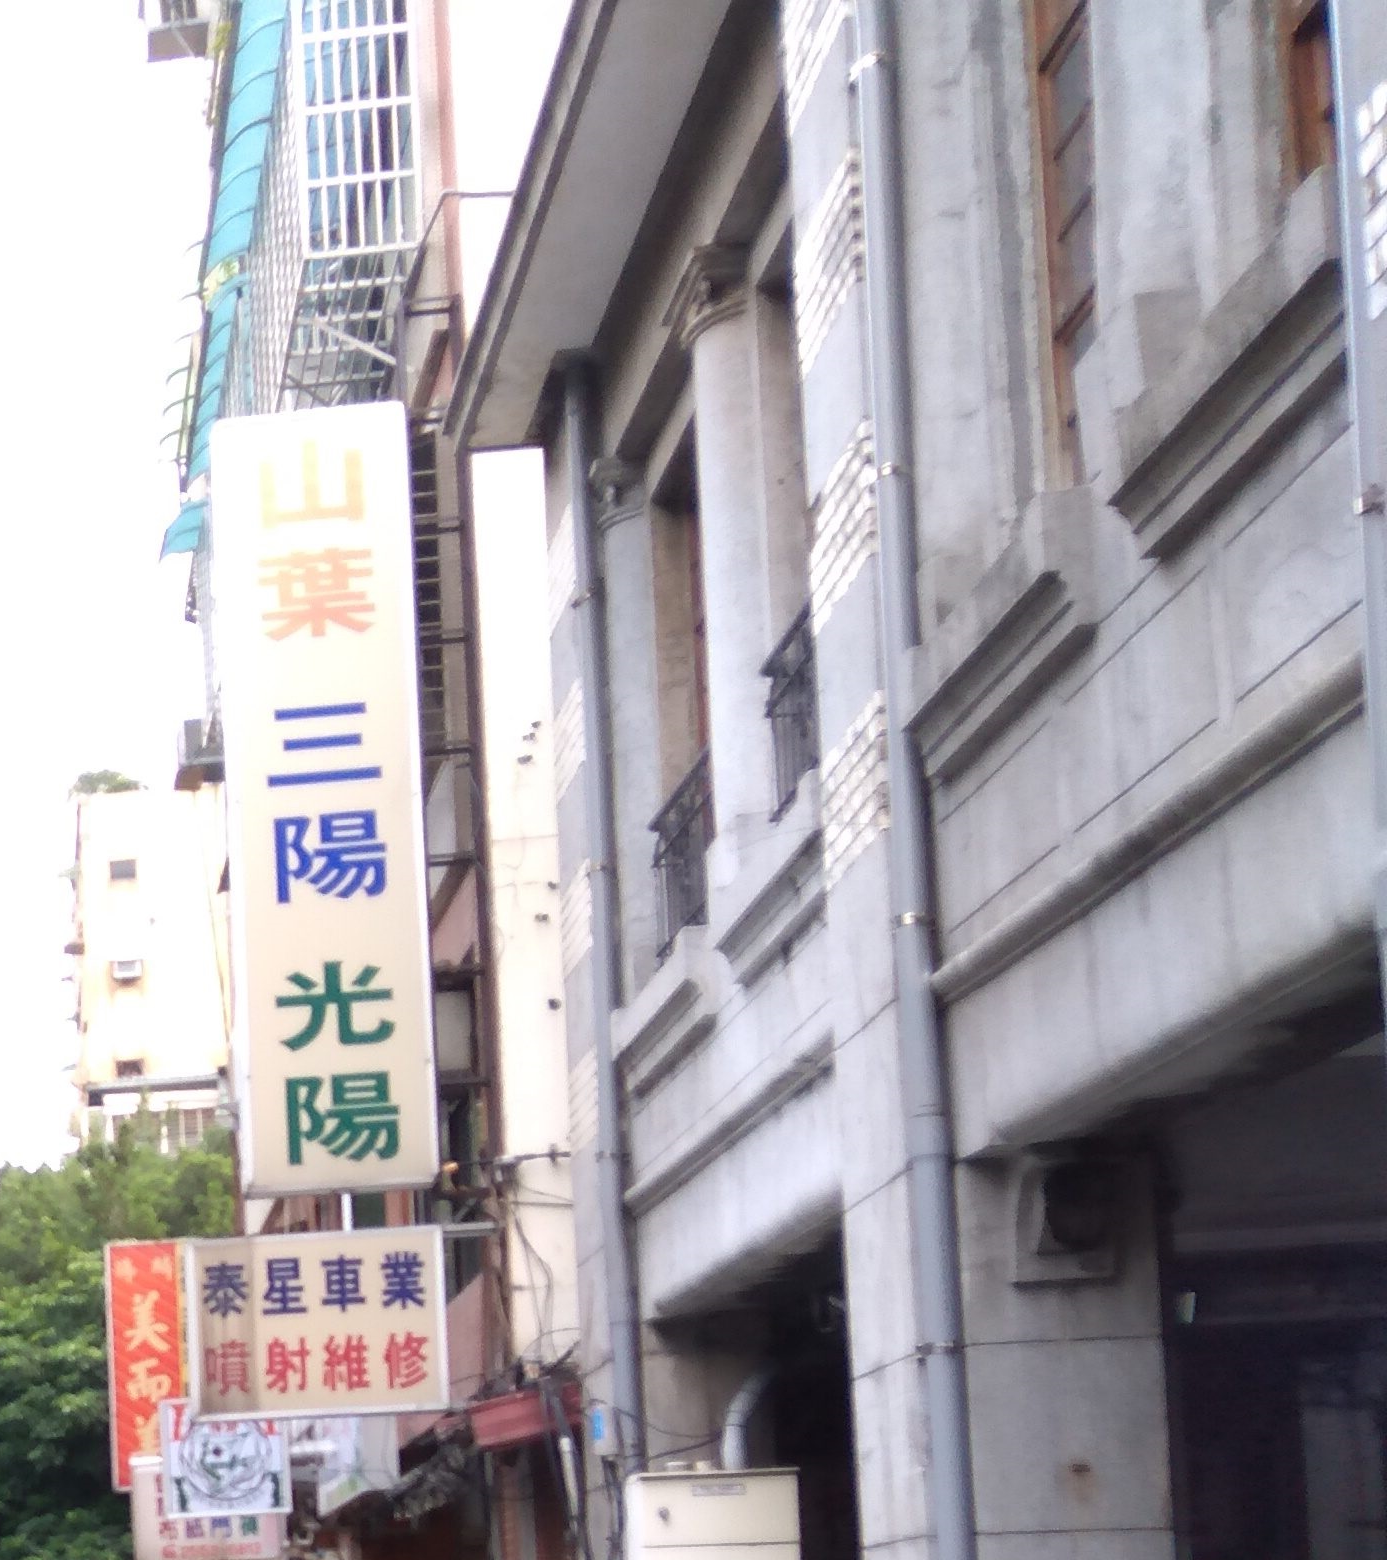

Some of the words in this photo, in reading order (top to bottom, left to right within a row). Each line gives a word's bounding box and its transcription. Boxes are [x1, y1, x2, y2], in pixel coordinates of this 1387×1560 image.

[258, 440, 376, 642] 山葉
[267, 702, 387, 903] 三陽
[275, 961, 400, 1166] 光陽
[203, 1252, 426, 1318] 泰星車業
[204, 1333, 430, 1395] 噴射維修
